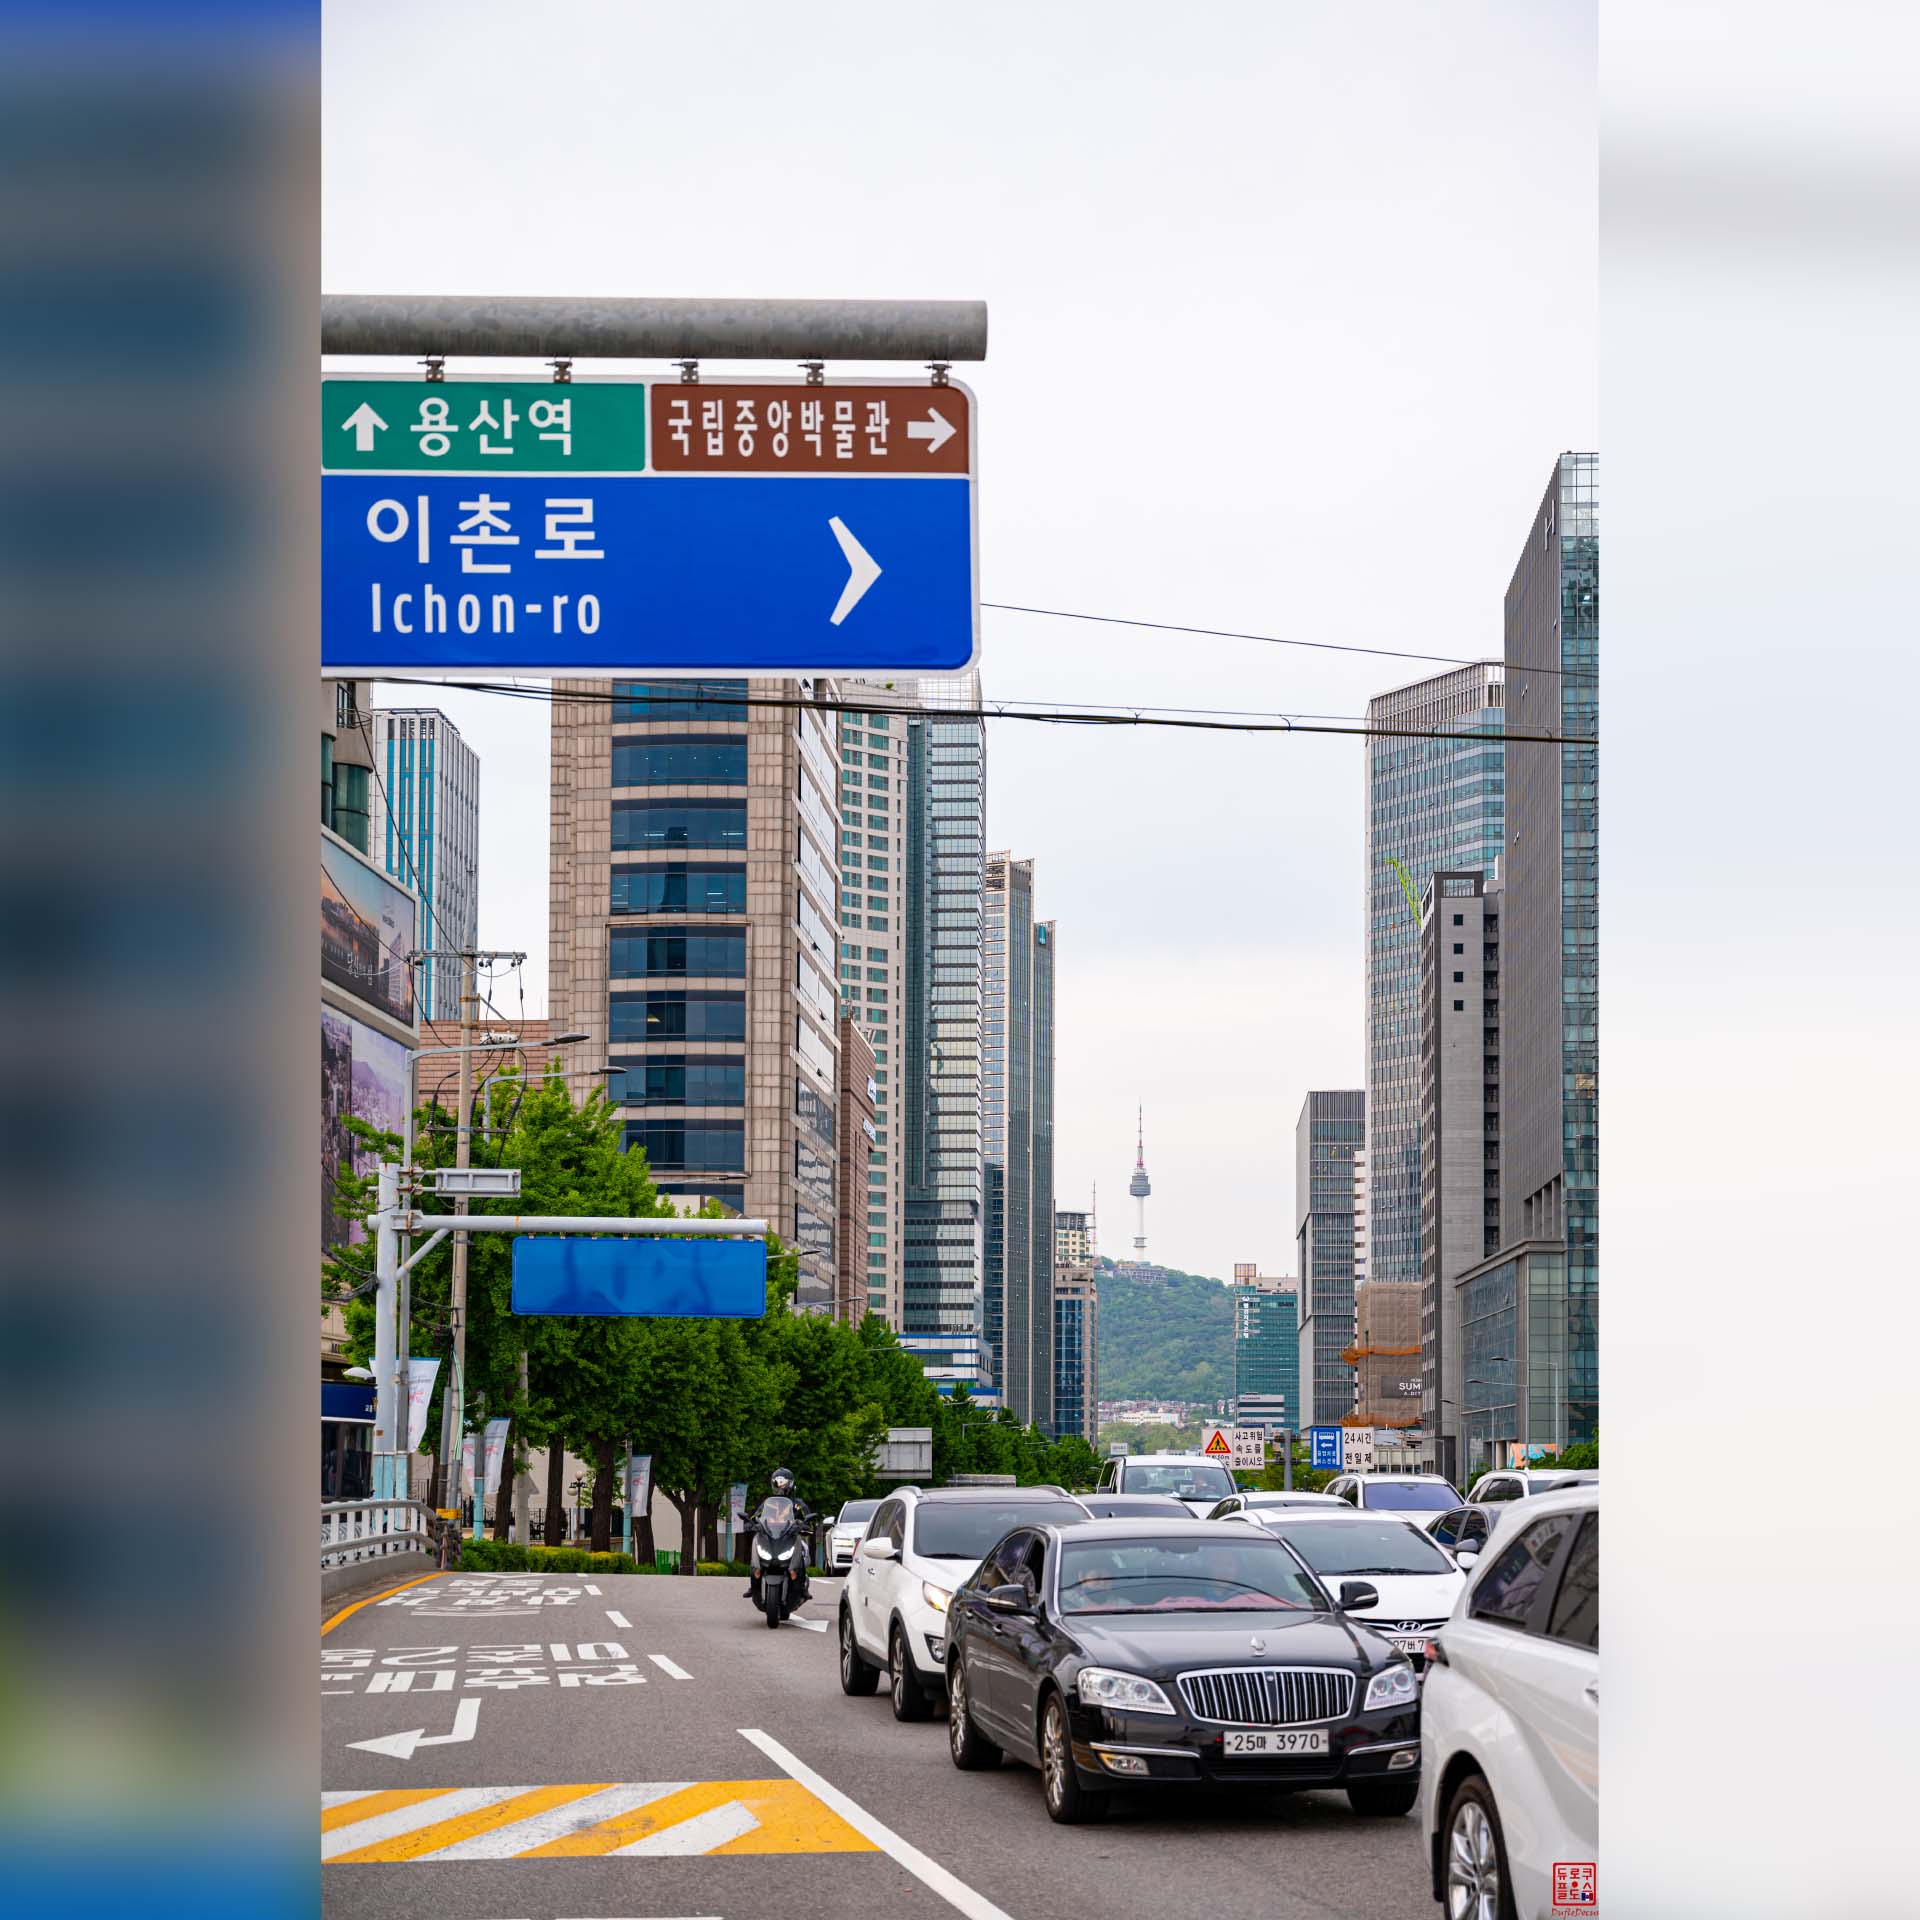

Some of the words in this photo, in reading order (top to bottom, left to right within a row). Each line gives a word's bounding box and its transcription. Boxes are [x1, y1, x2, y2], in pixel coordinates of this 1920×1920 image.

[409, 396, 573, 457] 용산역
[667, 399, 891, 460] 국립중앙박물관
[366, 493, 606, 575] 이촌로
[370, 582, 601, 635] Ichon-ro
[1399, 1382, 1423, 1391] SUM
[1235, 1456, 1263, 1466] 줄이시오
[1345, 1452, 1372, 1464] 전일제
[1234, 1734, 1266, 1751] 25마
[1276, 1733, 1320, 1750] 3970
